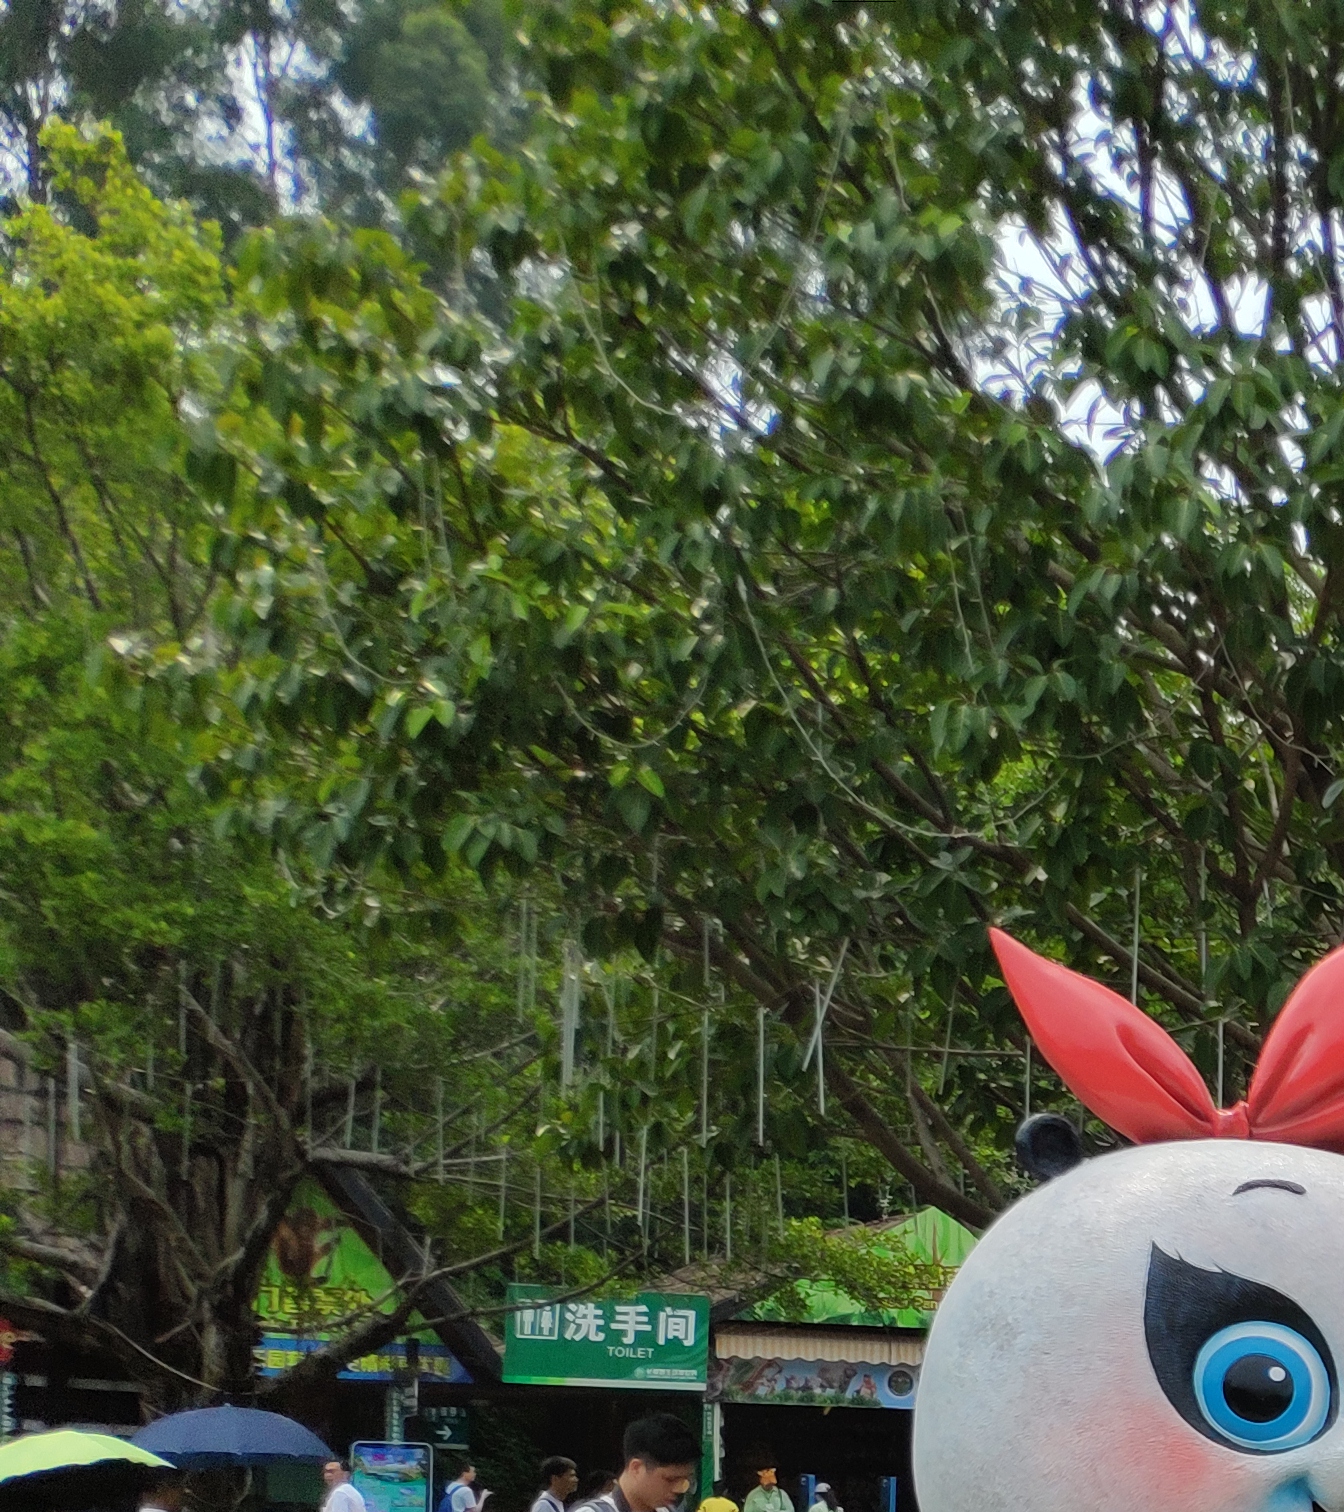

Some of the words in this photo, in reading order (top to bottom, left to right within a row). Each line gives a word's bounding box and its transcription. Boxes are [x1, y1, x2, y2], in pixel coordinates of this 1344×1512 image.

[563, 1303, 697, 1347] 洗手间
[606, 1346, 655, 1359] TOILET
